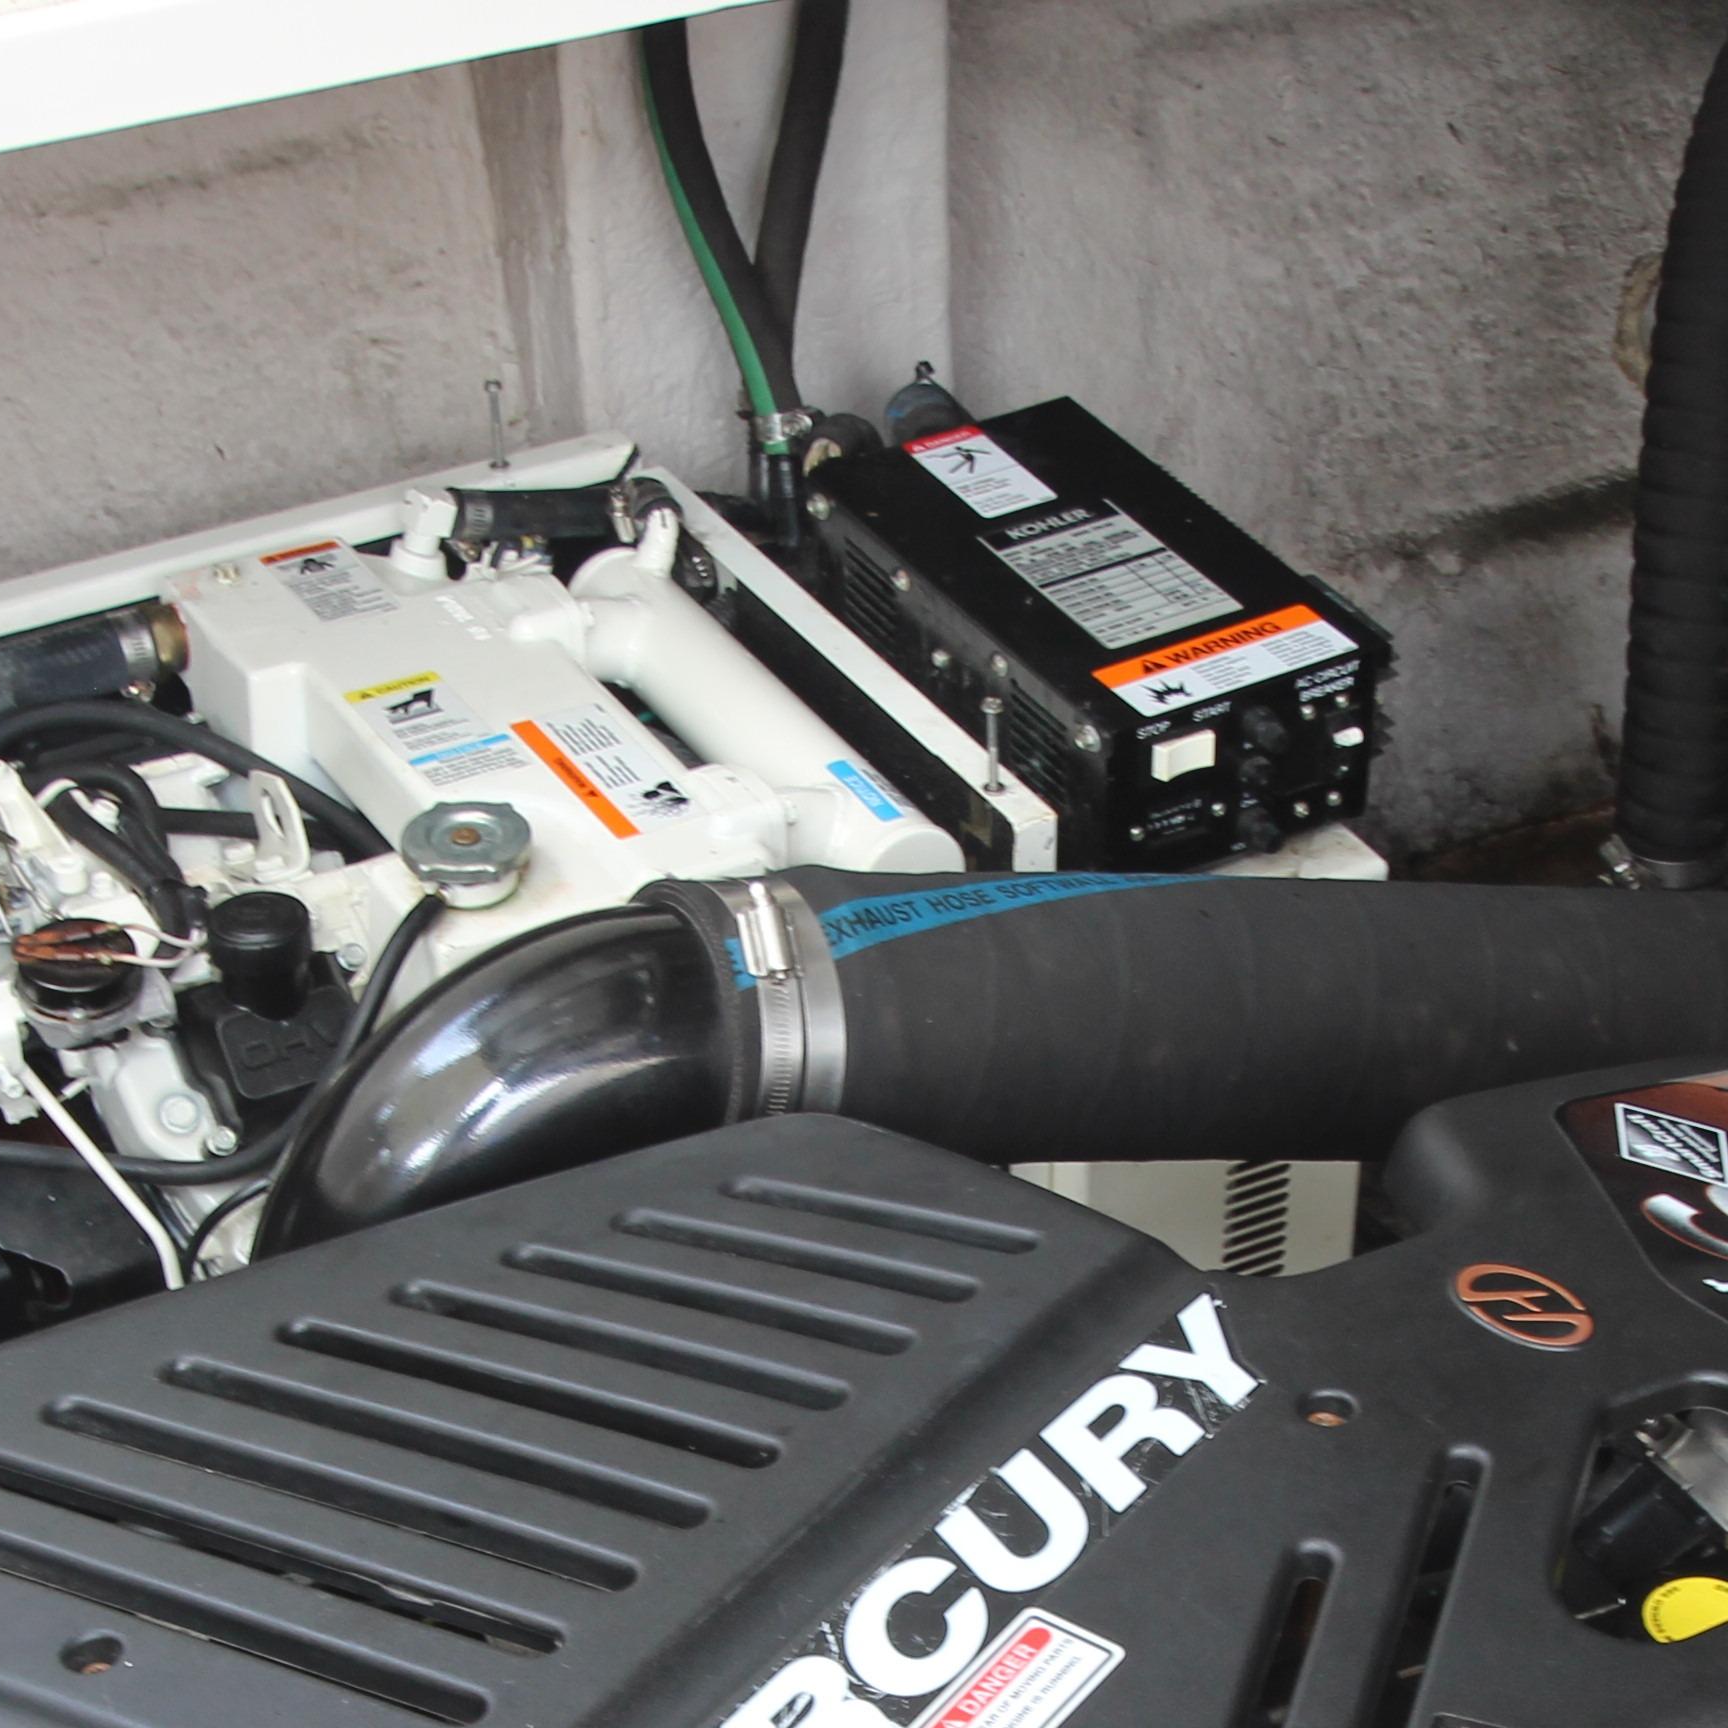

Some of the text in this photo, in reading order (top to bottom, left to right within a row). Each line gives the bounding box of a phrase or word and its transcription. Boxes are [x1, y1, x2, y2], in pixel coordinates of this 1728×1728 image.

[1004, 504, 1091, 543] KOHLER
[1164, 618, 1282, 667] WARNING
[375, 674, 430, 694] CAUTION
[1297, 675, 1356, 702] BREAKER
[1311, 659, 1362, 685] CIRCUIT
[1135, 699, 1233, 740] STOP START
[823, 871, 1113, 948] EXHAUST HOSE SOFTWALL
[955, 1641, 1038, 1716] DANGER
[995, 1699, 1012, 1712] OF
[1008, 1665, 1046, 1700] MOVING
[1041, 1636, 1074, 1666] PARTS
[1029, 1693, 1044, 1704] IS
